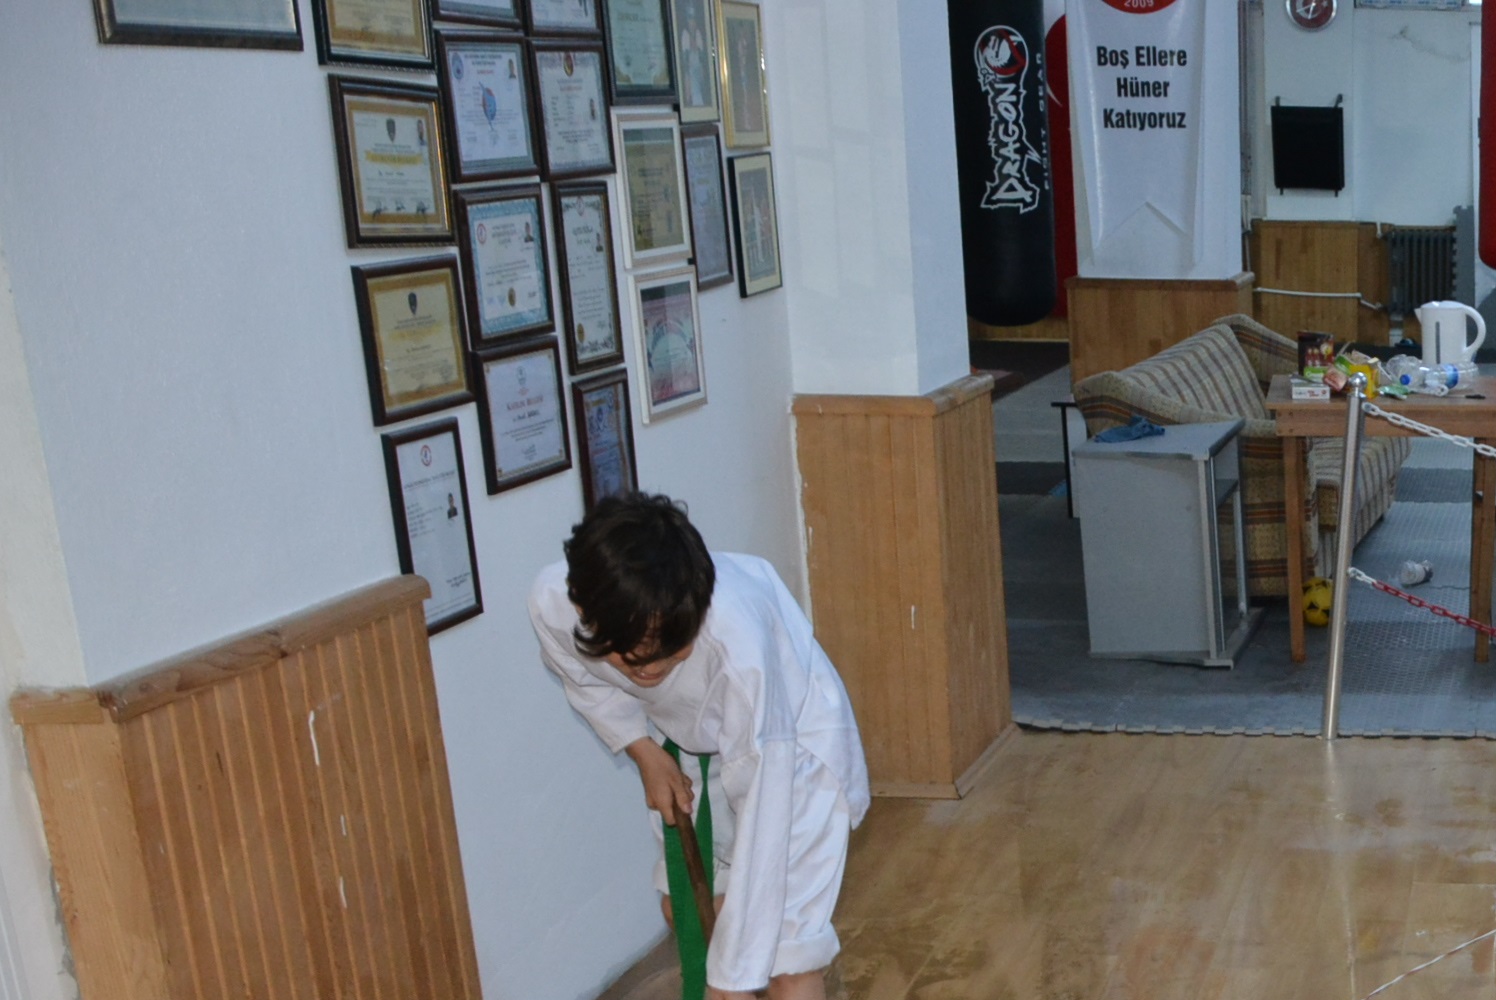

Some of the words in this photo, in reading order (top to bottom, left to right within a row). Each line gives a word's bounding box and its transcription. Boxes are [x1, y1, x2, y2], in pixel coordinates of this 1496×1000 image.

[1096, 46, 1130, 69] Boş
[1135, 46, 1188, 67] Ellere
[1116, 77, 1170, 98] Hüner
[1103, 108, 1187, 131] Katıyoruz
[990, 83, 1033, 202] DRAGON
